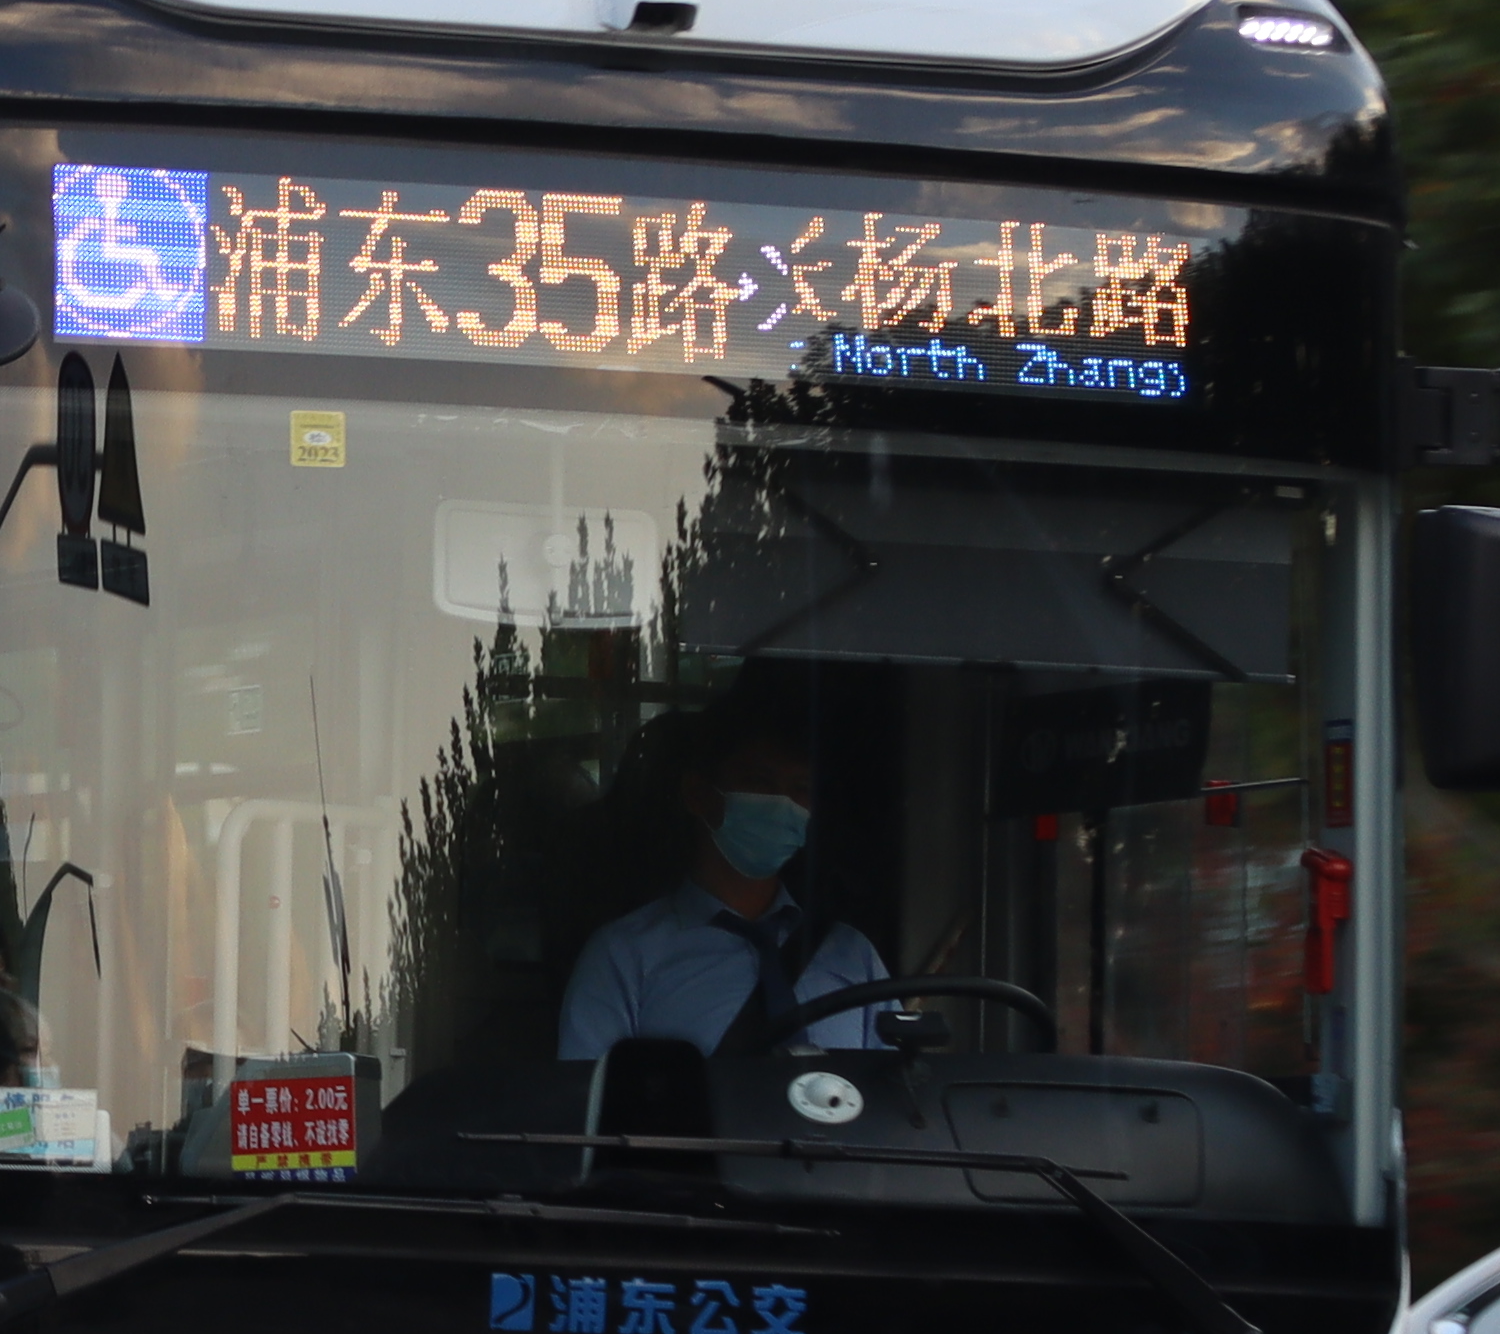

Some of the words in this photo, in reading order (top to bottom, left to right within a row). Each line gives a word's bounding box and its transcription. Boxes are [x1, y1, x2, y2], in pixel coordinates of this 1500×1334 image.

[208, 175, 740, 363] 浦东35路
[833, 333, 985, 382] North
[297, 446, 340, 463] 2023
